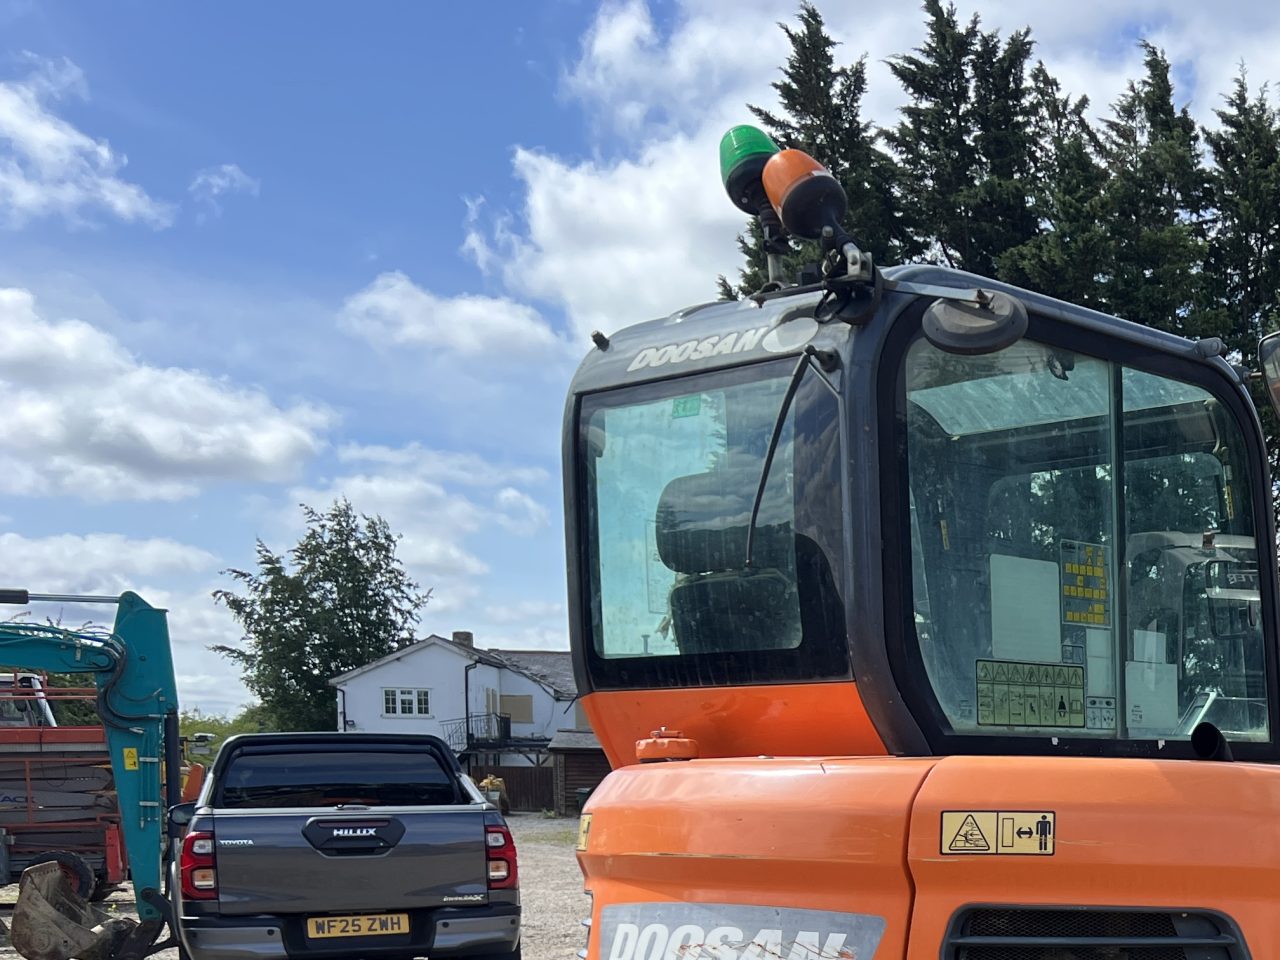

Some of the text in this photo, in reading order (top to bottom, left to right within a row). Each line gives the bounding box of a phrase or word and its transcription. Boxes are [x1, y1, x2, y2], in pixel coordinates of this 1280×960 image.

[627, 325, 770, 372] DOOSAN
[333, 828, 377, 836] HILUX
[315, 916, 402, 934] WF25 ZWH
